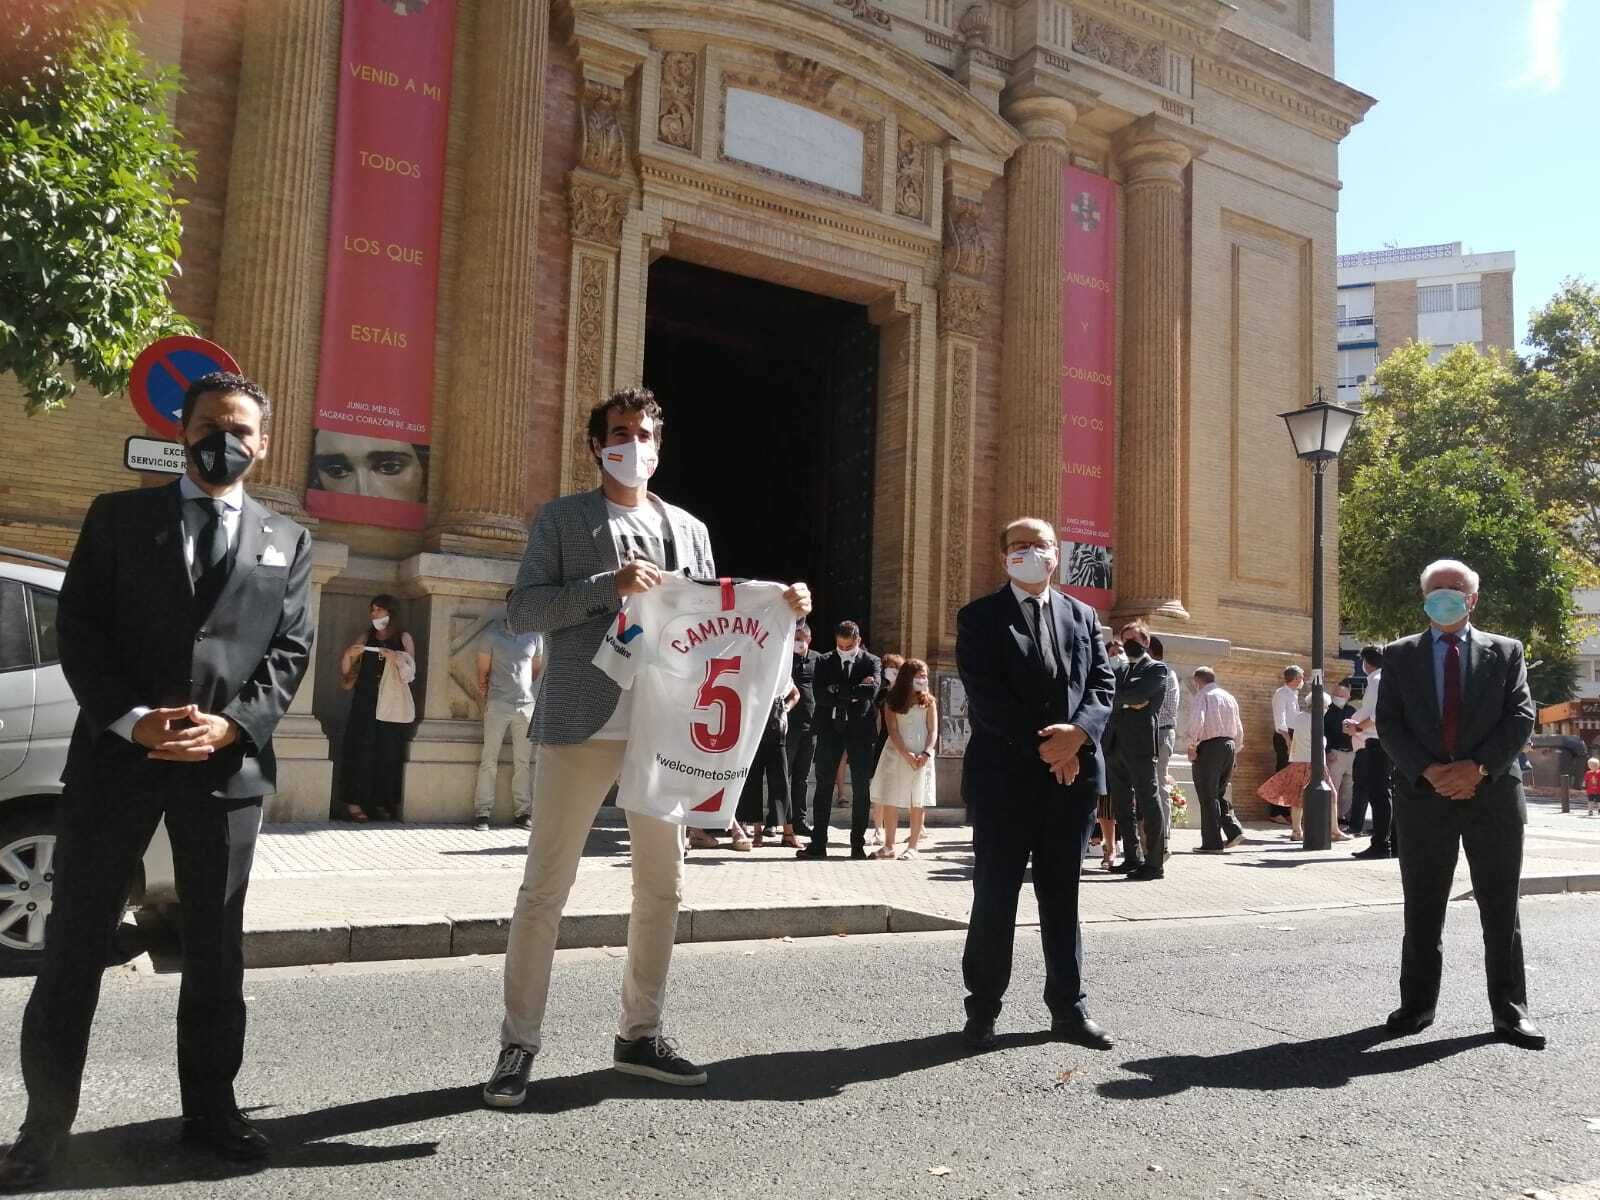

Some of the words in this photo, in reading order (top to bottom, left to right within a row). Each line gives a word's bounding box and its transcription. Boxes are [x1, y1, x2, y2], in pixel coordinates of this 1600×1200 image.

[349, 62, 399, 87] VENID
[404, 78, 417, 93] A
[359, 150, 421, 178] TODOS
[344, 235, 380, 255] LOS
[387, 244, 424, 265] QUE
[351, 324, 408, 348] ESTÁIS
[1080, 319, 1089, 333] Y
[388, 407, 401, 416] DEL
[395, 420, 406, 430] DE
[1071, 415, 1088, 428] YO
[1090, 418, 1104, 432] OS
[130, 455, 178, 468] SERVICIOS
[689, 655, 742, 754] 5
